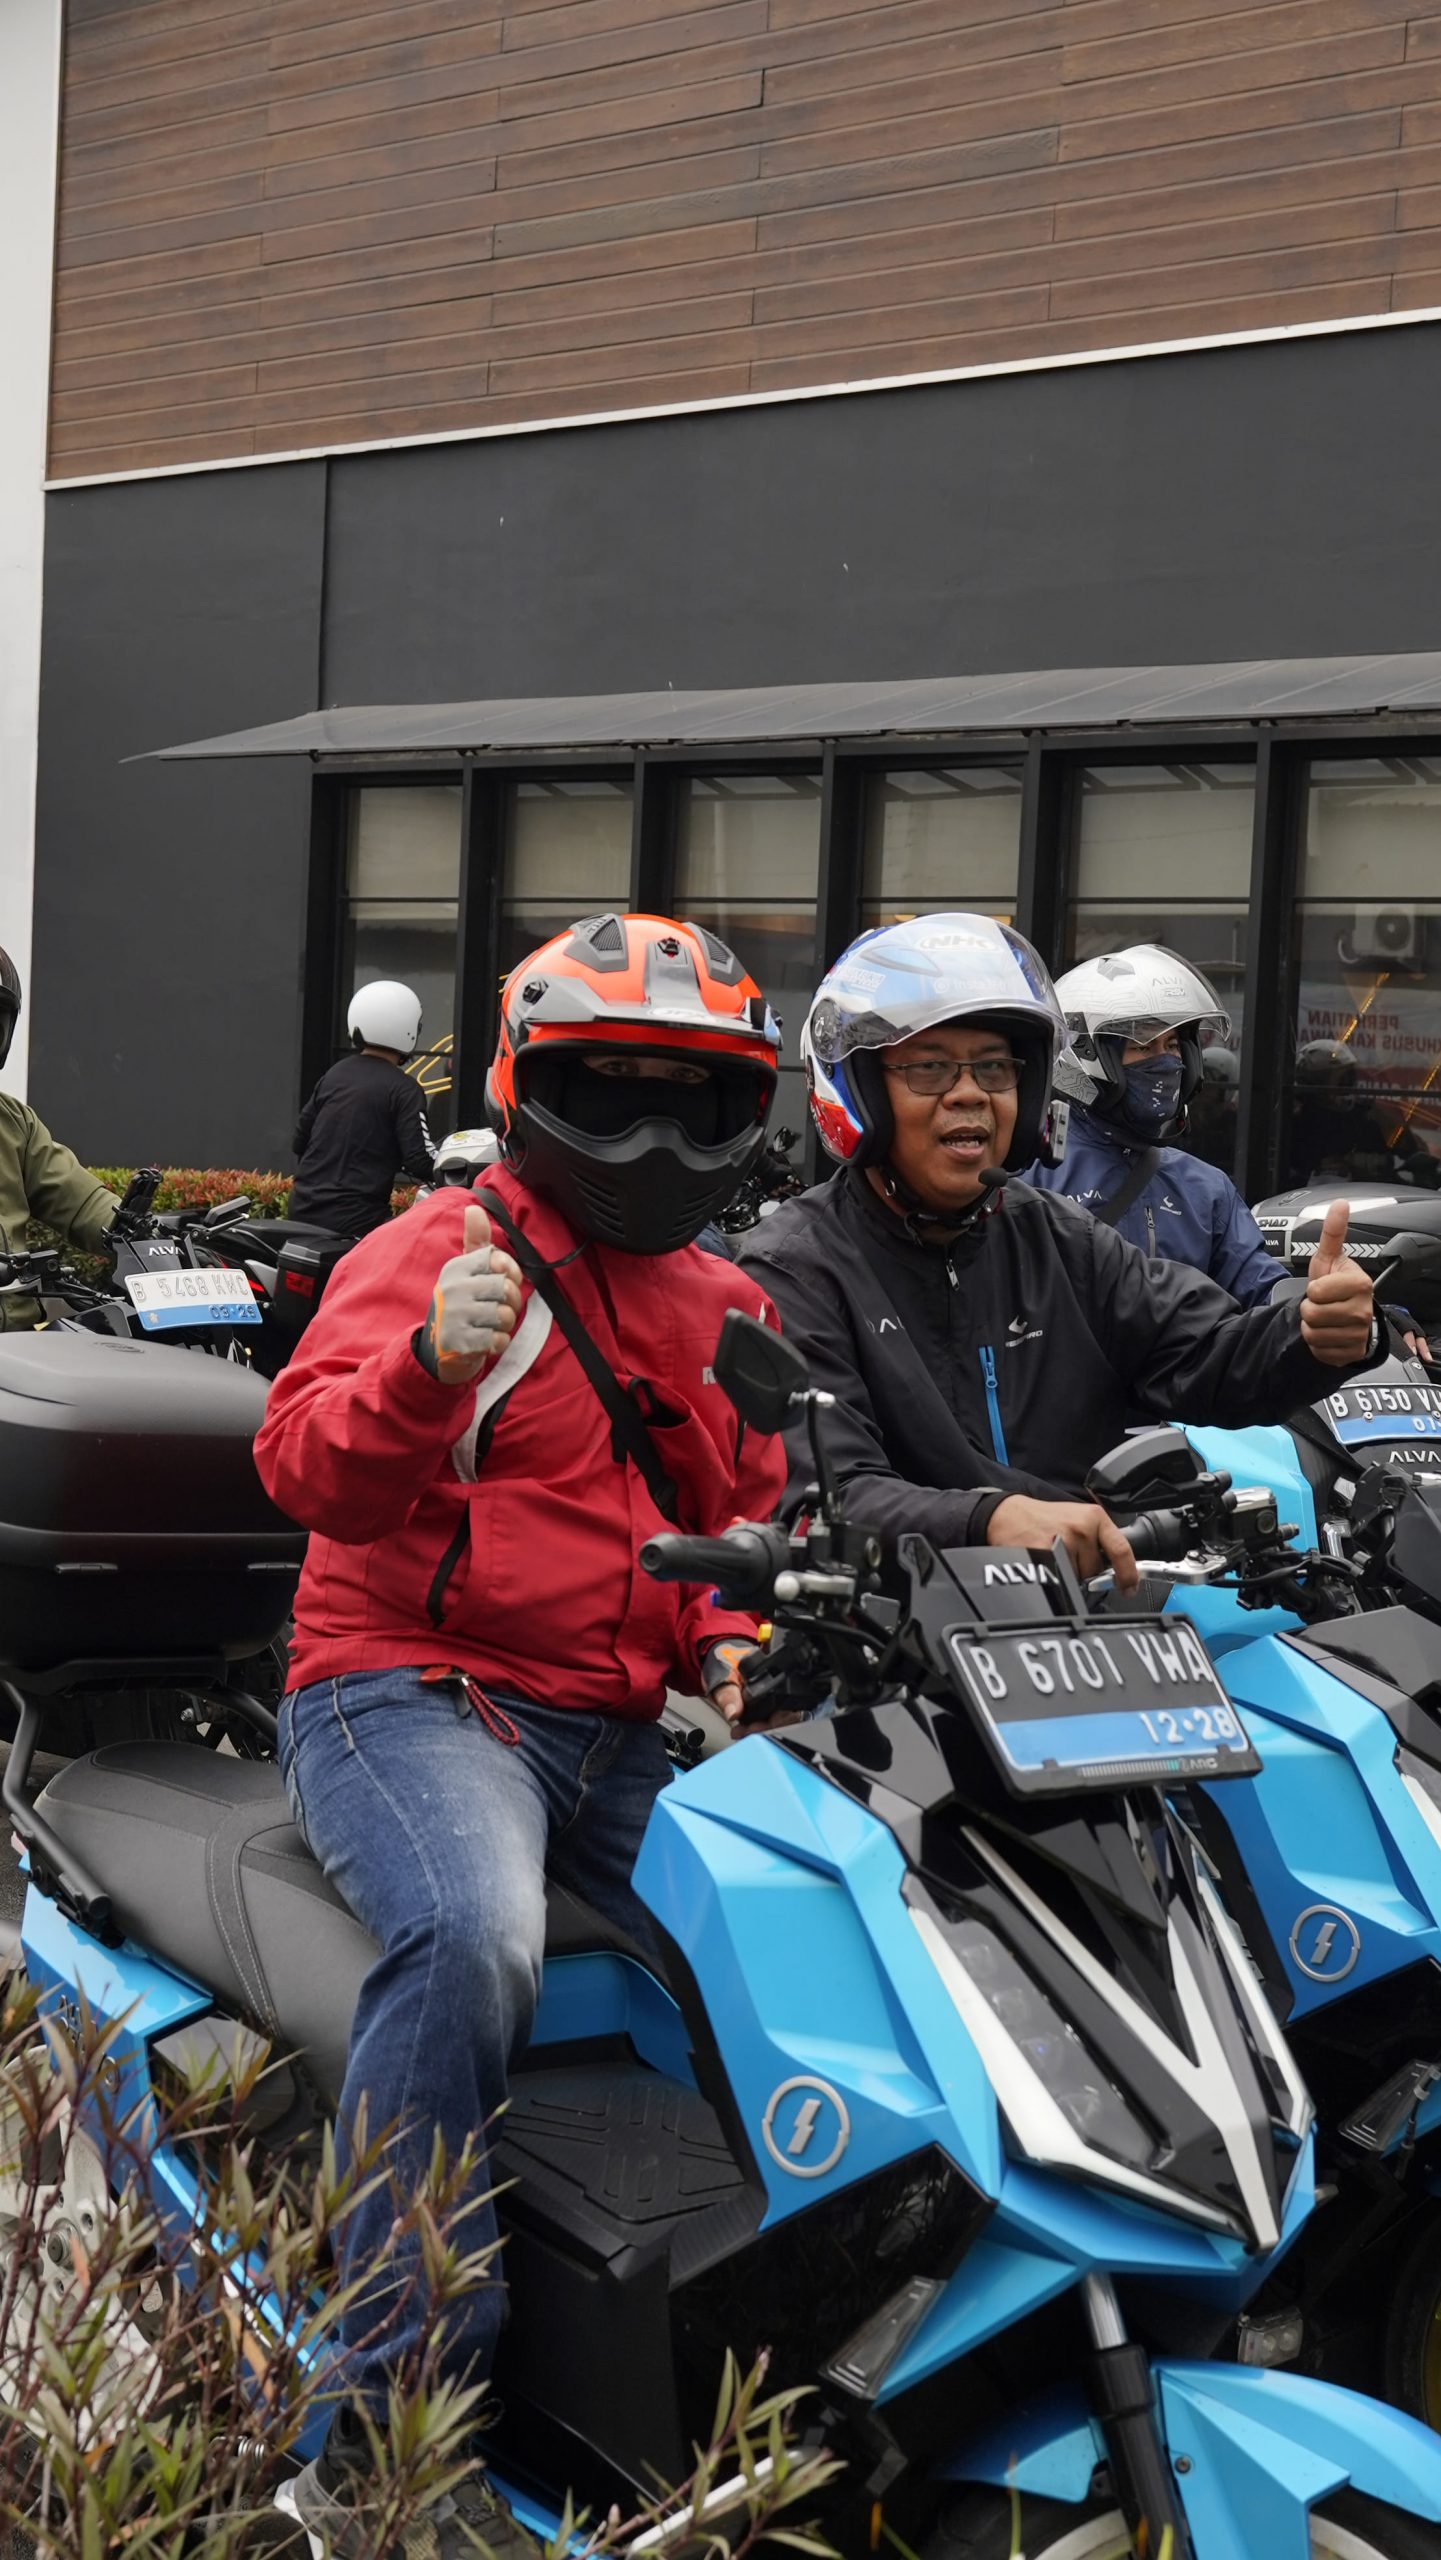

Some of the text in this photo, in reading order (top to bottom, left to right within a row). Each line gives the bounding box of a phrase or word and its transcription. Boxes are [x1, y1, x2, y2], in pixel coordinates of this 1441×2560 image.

[928, 935, 991, 949] NHK
[1258, 1219, 1289, 1228] SHAD
[148, 1246, 185, 1257] ALVA
[131, 1281, 147, 1303] B
[1329, 1393, 1349, 1418] B
[1355, 1388, 1412, 1411] 6150
[1389, 1450, 1441, 1463] ALVA
[984, 1562, 1060, 1586] ALVA
[969, 1631, 1214, 1699] B 6701 VWA
